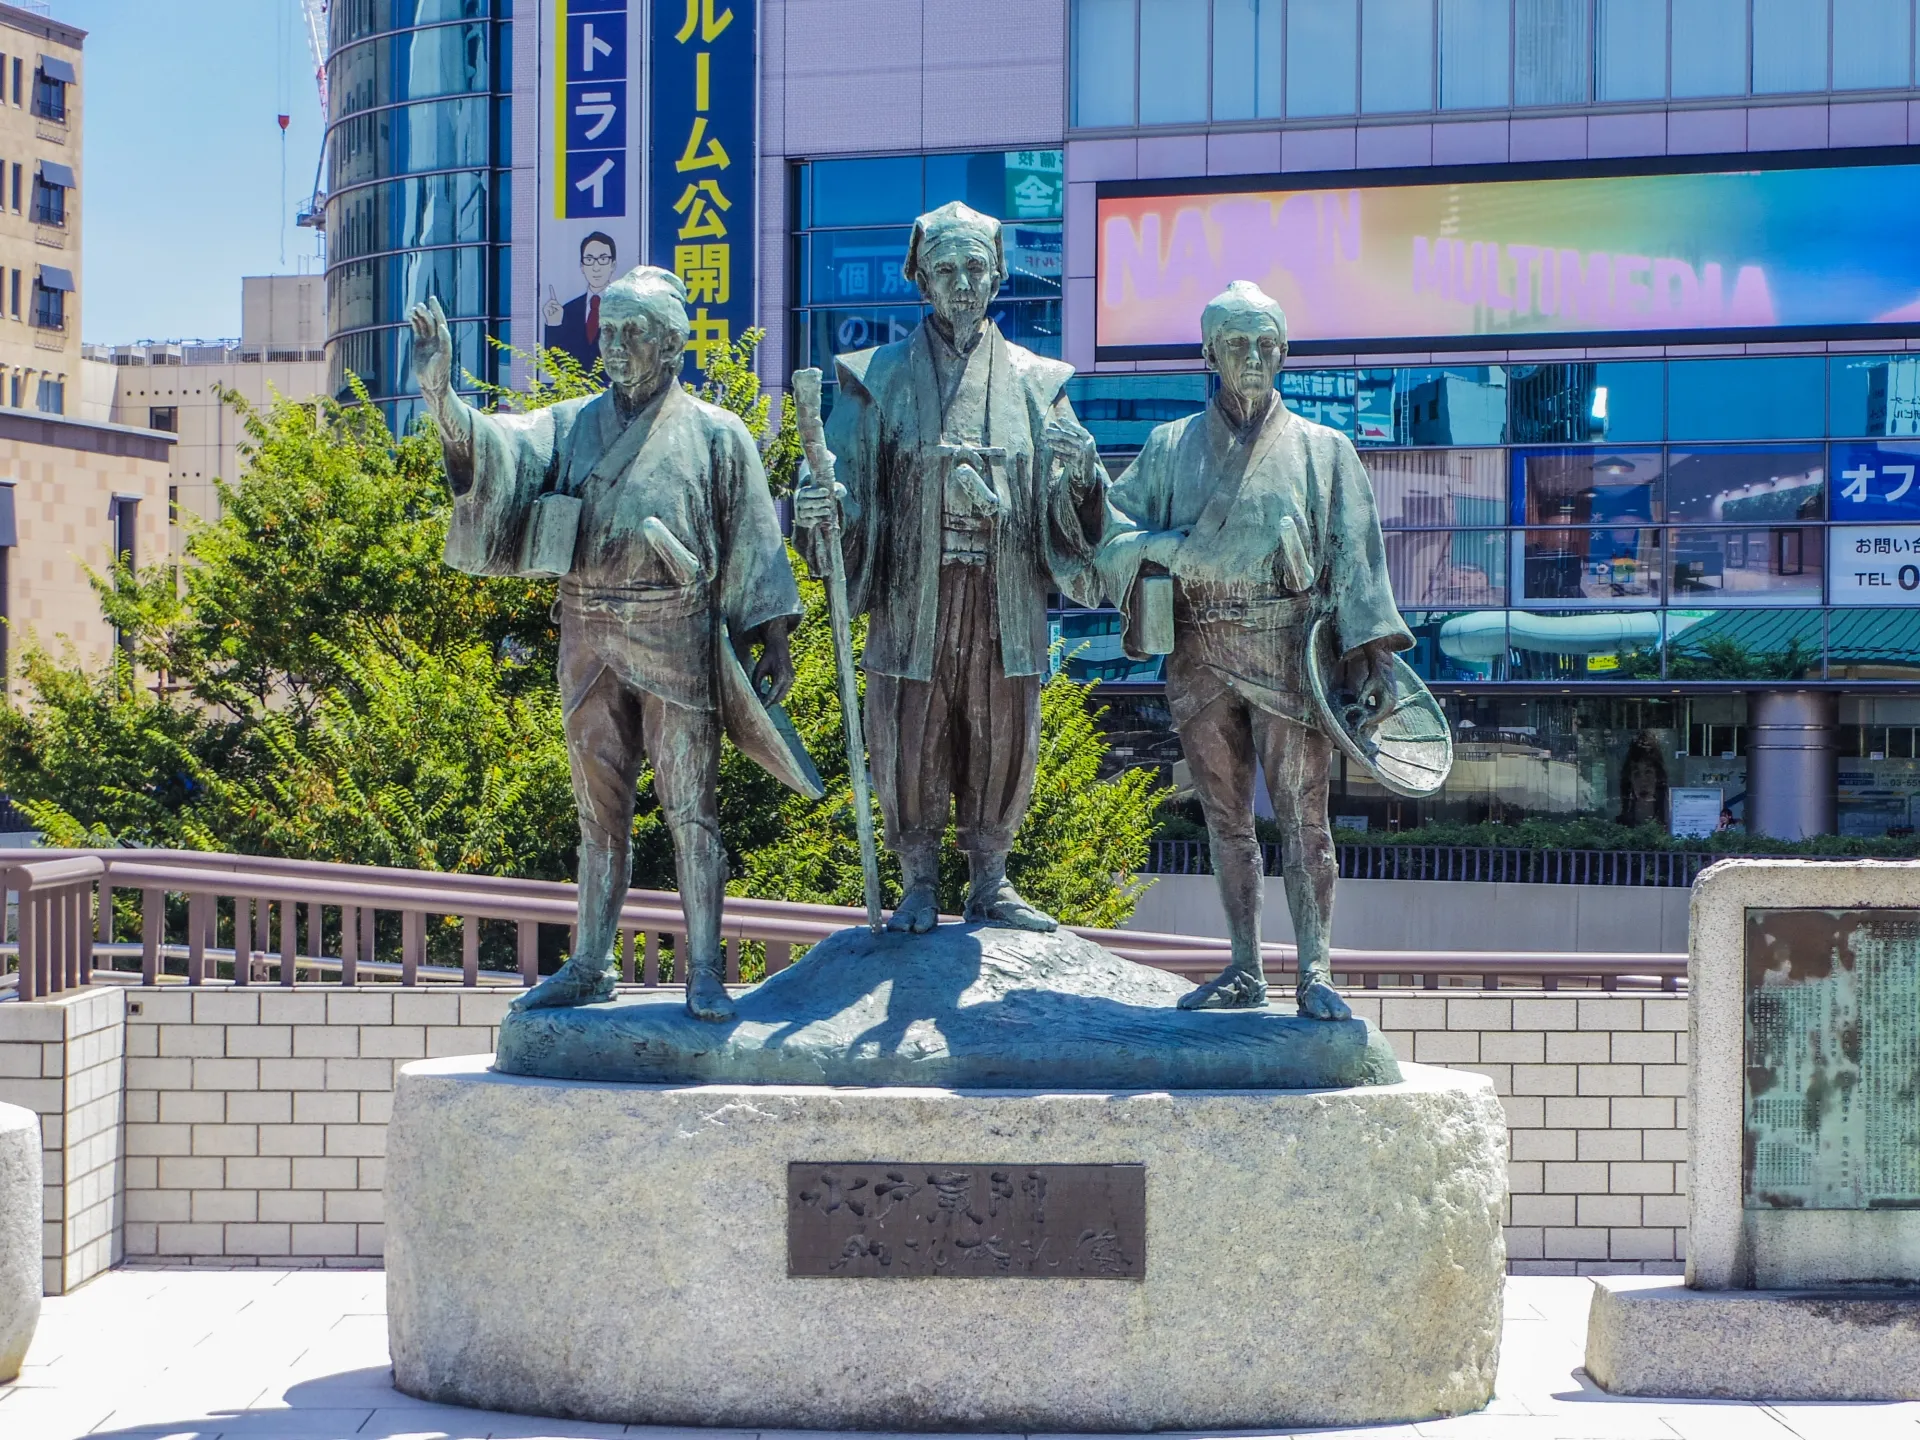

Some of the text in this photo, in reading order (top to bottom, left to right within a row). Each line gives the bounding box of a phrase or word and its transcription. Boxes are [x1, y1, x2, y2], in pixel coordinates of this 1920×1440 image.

[575, 23, 617, 208] トライ
[1412, 236, 1778, 326] MULTIMEDIA
[1841, 464, 1920, 503] オフ
[1854, 572, 1892, 586] TEL
